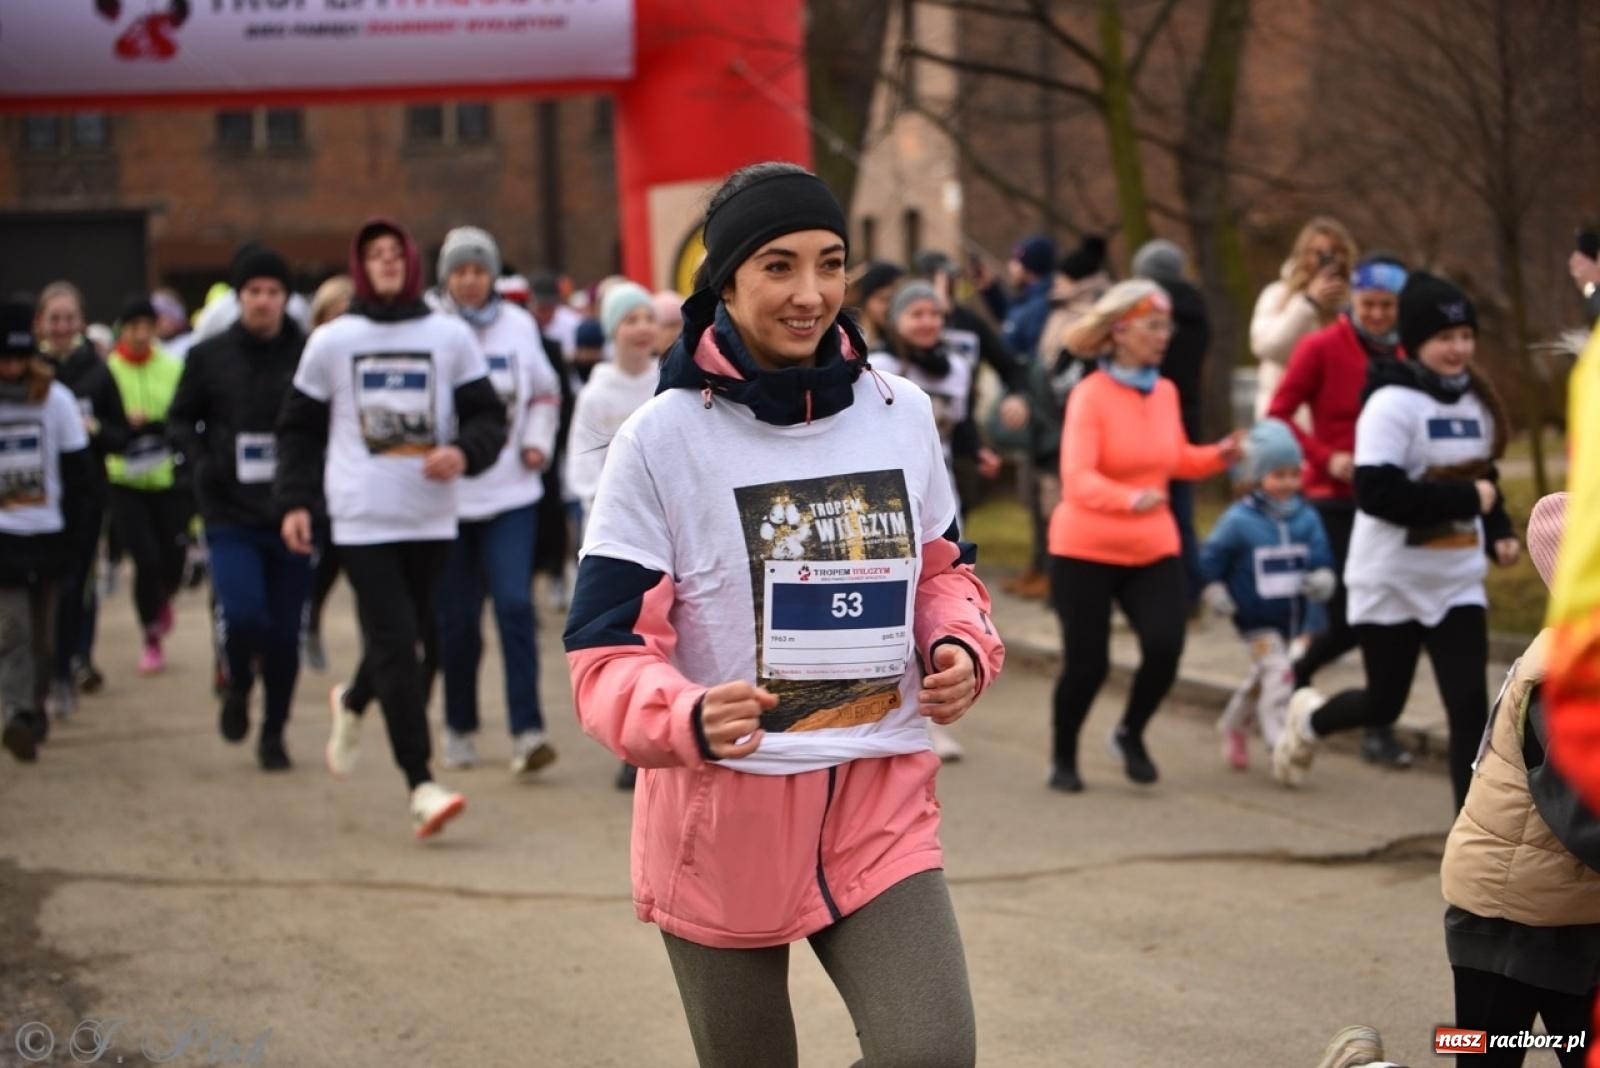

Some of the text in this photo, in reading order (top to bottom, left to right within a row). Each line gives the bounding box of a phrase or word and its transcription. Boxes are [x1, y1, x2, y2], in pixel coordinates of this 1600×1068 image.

[809, 498, 860, 518] TROPEM
[815, 511, 907, 543] WILCZYM
[813, 567, 891, 577] TROPEM WILCZYM
[831, 592, 864, 618] 53
